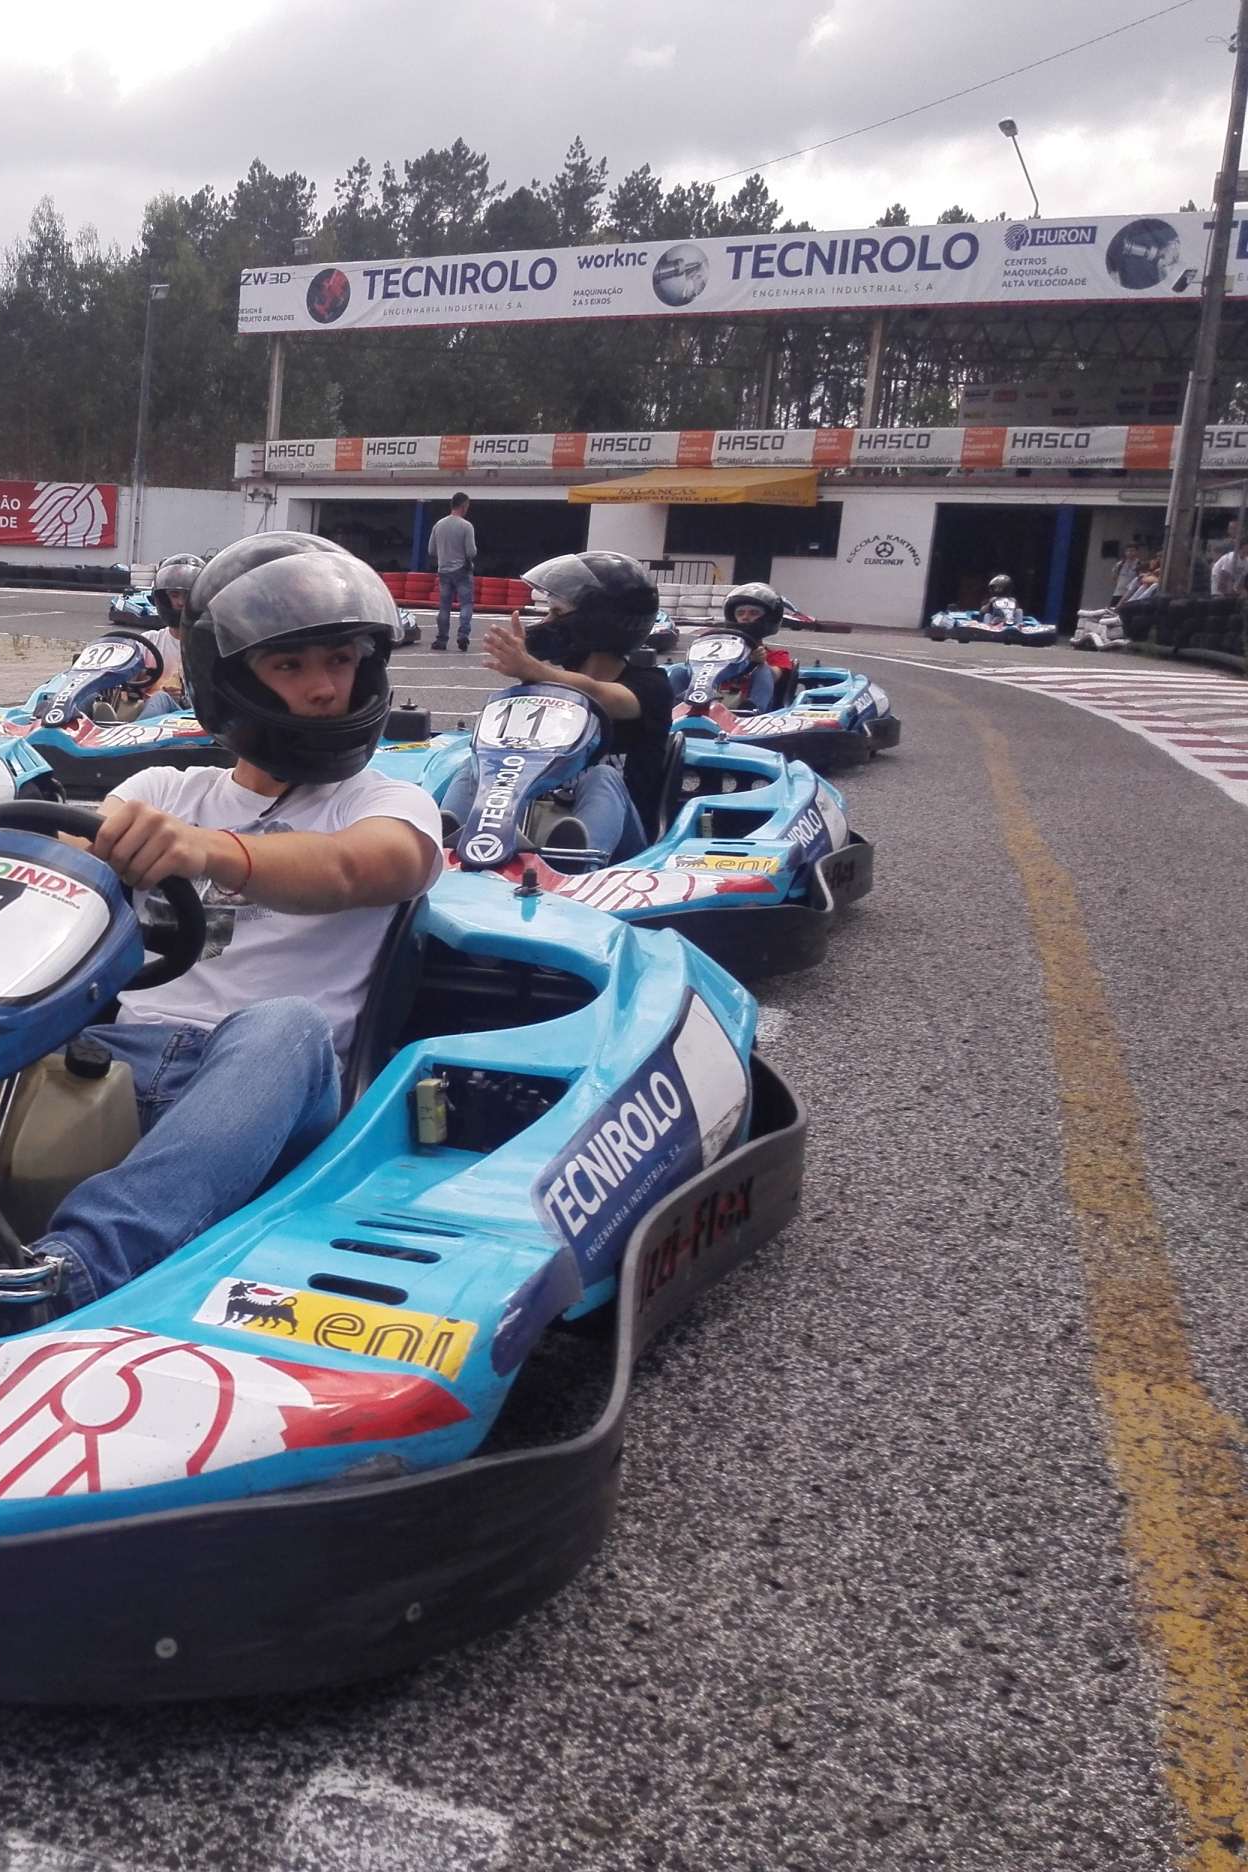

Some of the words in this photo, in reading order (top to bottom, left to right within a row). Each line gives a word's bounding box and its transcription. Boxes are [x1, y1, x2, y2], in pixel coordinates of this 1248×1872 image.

[1035, 228, 1092, 244] HURON
[577, 248, 648, 270] worknc
[726, 232, 980, 280] TECNIROLO
[1004, 257, 1047, 267] CENTROS
[362, 256, 558, 301] TECNIROLO
[1003, 267, 1068, 278] MAQUINAÇÃO
[1002, 278, 1027, 289] ALTA
[1027, 277, 1087, 288] VELOCIDADE
[573, 286, 623, 297] MAQUINAÇÃO
[752, 286, 825, 298] ENGENHARIA
[473, 439, 529, 454] HASCO
[591, 437, 651, 452] HASCO
[718, 435, 785, 451] HASCO
[859, 433, 931, 449] HASCO
[1012, 432, 1091, 449] HASCO
[1202, 431, 1247, 448] ASC
[268, 444, 315, 458] HASCO
[366, 441, 418, 456] HASCO
[886, 534, 921, 567] KARTING
[81, 646, 115, 665] 30
[705, 641, 723, 659] 2
[494, 704, 547, 739] 11
[714, 856, 772, 874] eni
[585, 1208, 631, 1262] ENGENHARIA
[313, 1311, 461, 1371] eni
